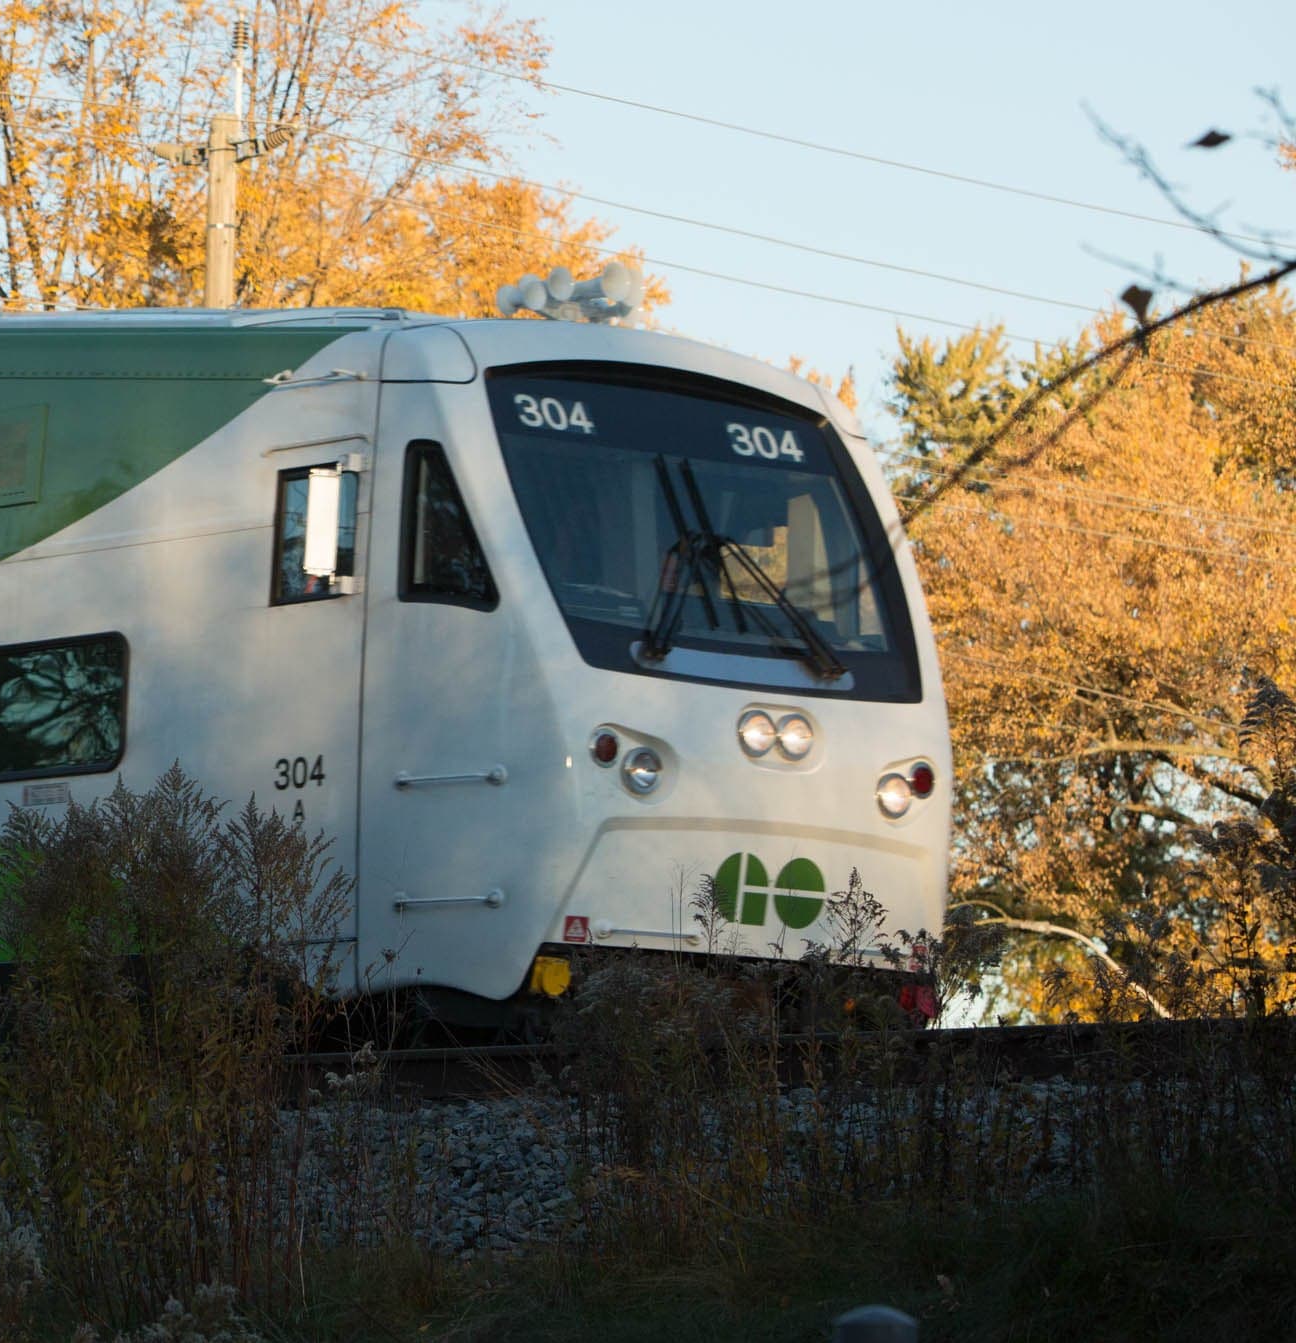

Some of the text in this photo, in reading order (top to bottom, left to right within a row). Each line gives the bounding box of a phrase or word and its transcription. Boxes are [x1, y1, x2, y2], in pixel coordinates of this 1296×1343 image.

[514, 394, 594, 434] 304
[726, 423, 803, 463] 304
[274, 754, 325, 791] 304
[292, 799, 306, 821] A
[714, 852, 825, 929] GO
